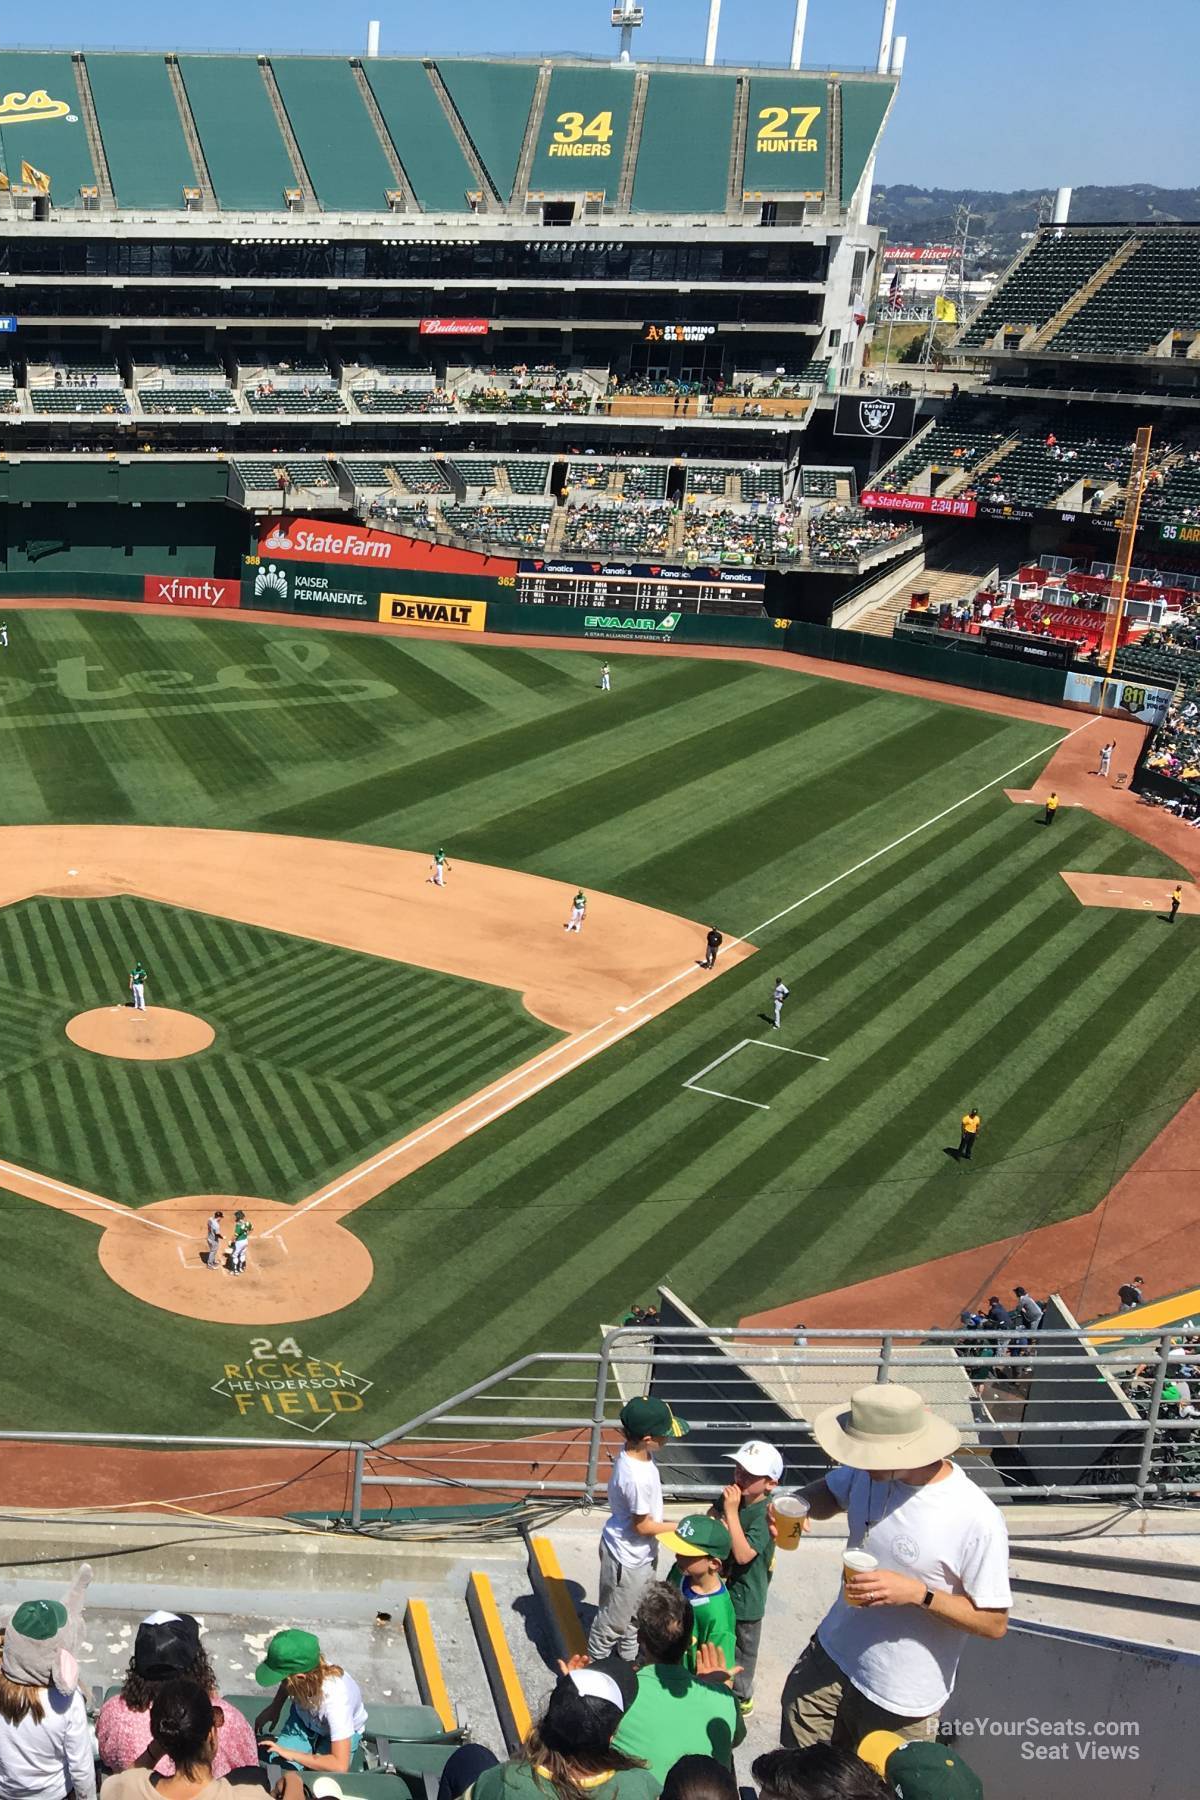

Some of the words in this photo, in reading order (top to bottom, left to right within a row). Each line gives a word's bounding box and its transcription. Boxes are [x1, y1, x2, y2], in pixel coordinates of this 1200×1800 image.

[553, 111, 613, 142] 34
[758, 106, 821, 138] 27
[548, 143, 611, 157] FINGERS
[757, 139, 818, 152] HUNTER
[423, 319, 485, 334] Budweiser
[930, 499, 951, 513] 2:34
[951, 501, 969, 514] PM
[1061, 513, 1076, 522] MPH
[1162, 525, 1177, 539] 35
[294, 575, 329, 589] KAISER
[498, 576, 516, 588] 362
[720, 572, 752, 582] Fanatics
[158, 579, 225, 605] xfinity
[294, 589, 364, 605] PERMANENTE
[774, 618, 793, 629] 367
[1123, 685, 1146, 704] 811
[250, 1337, 303, 1360] 24
[223, 1360, 344, 1380] RICKEY
[228, 1377, 358, 1392] HENDERSON
[234, 1390, 365, 1416] FIELD
